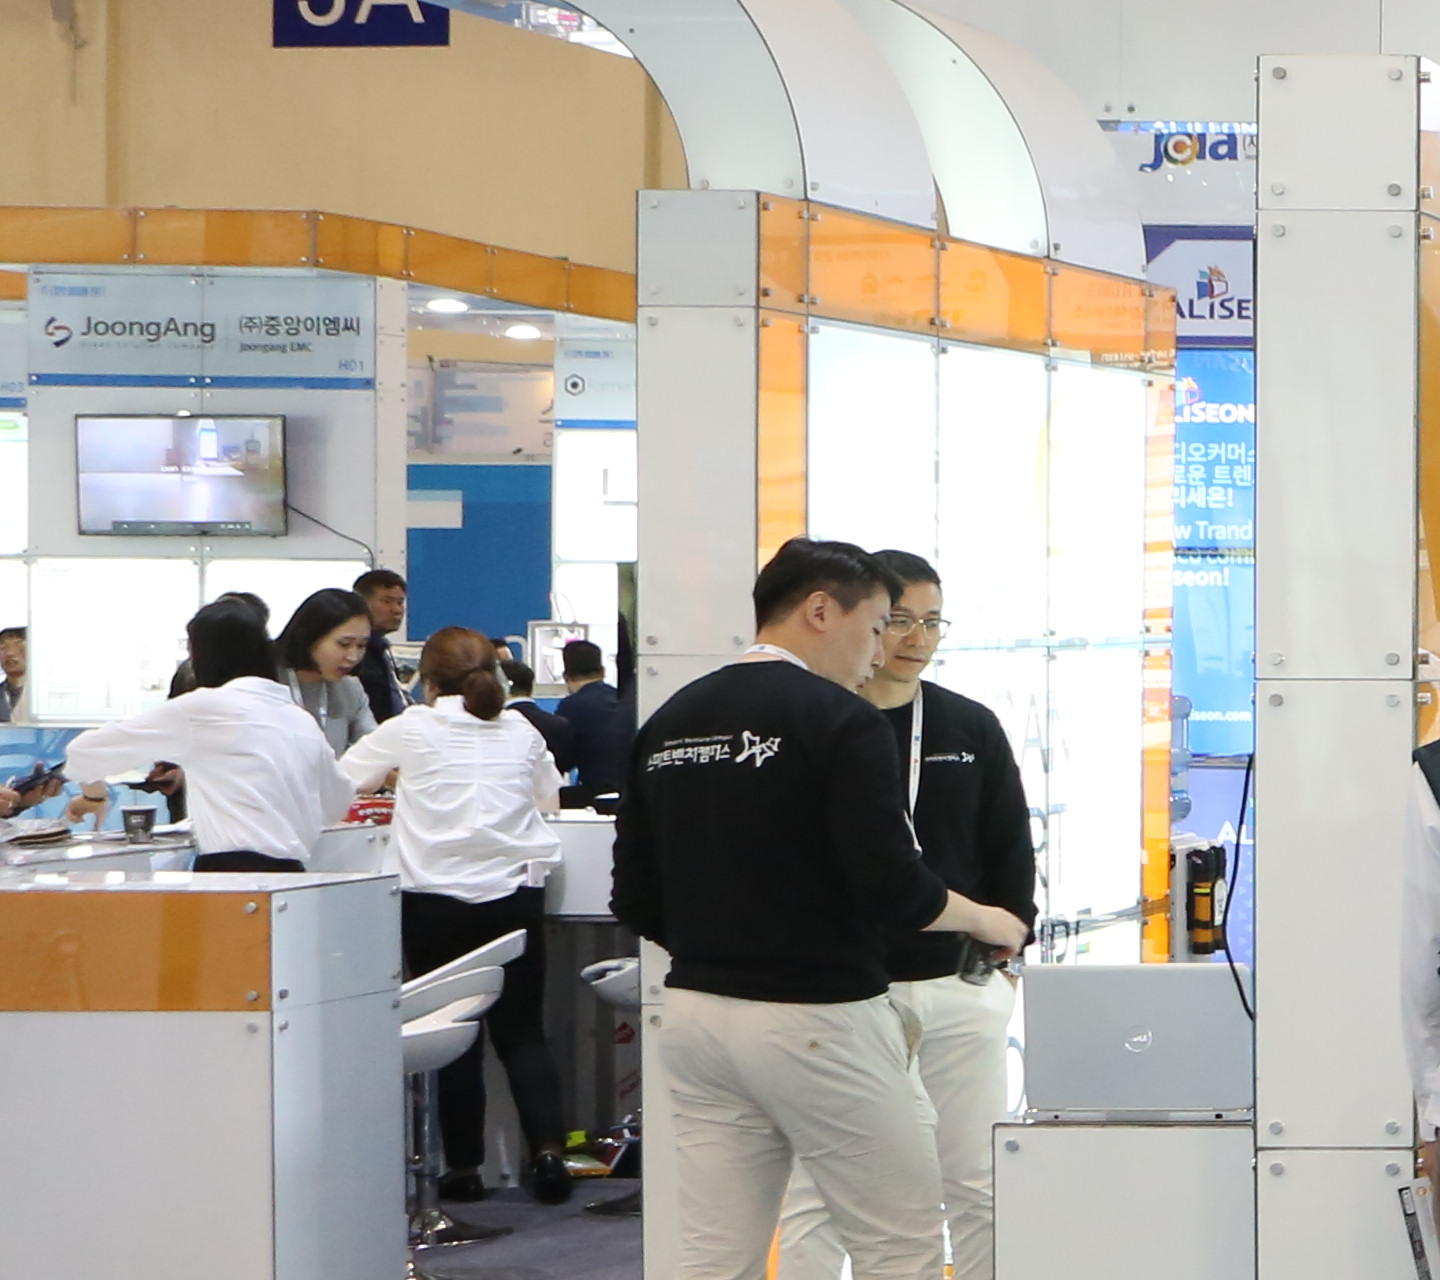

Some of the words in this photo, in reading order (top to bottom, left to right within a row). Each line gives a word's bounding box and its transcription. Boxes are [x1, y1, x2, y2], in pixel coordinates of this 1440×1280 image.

[80, 316, 216, 343] JoongAng
[239, 316, 361, 336] (주)중앙이엠씨
[1174, 402, 1254, 423] LISEON
